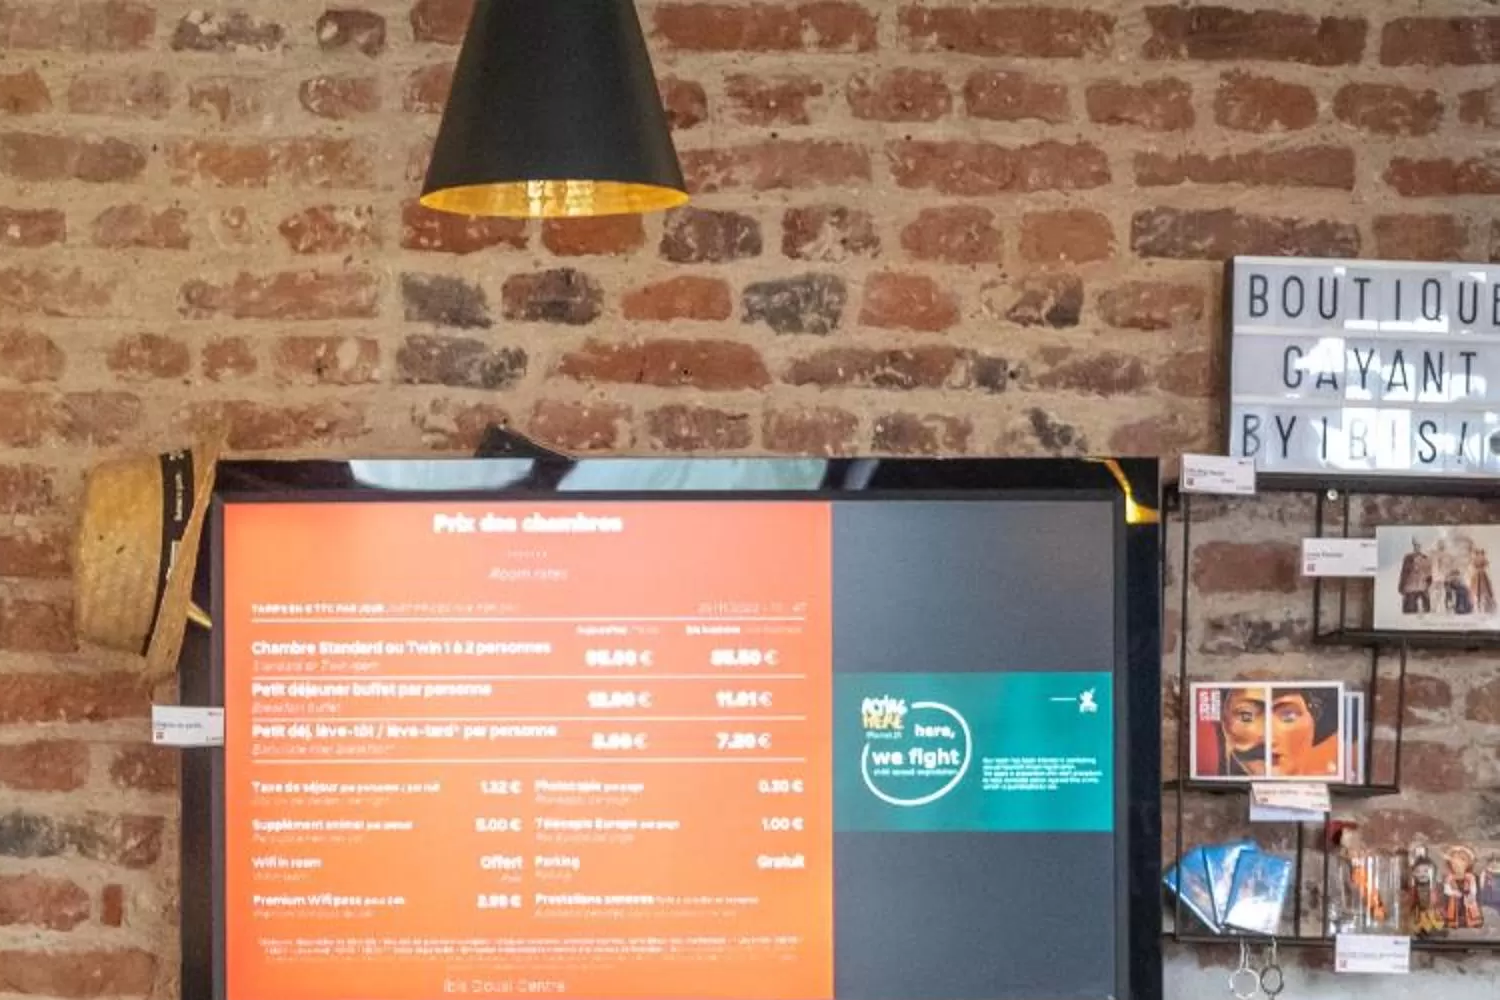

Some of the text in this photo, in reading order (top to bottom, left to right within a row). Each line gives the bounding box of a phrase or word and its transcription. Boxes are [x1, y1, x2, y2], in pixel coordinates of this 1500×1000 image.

[1283, 345, 1477, 393] GAYANT
[1242, 413, 1298, 459] BY
[433, 512, 477, 533] Prix
[251, 640, 317, 656] Chambre
[319, 640, 383, 656] Standard
[385, 642, 404, 655] ou
[405, 639, 442, 655] Twin
[475, 642, 552, 657] personnes
[251, 682, 285, 697] Petit
[251, 724, 285, 738] Petit
[914, 723, 956, 740] here,
[871, 746, 961, 769] we fight
[480, 854, 523, 869] Offert
[534, 855, 581, 872] Parking
[757, 853, 805, 869] Gratuit
